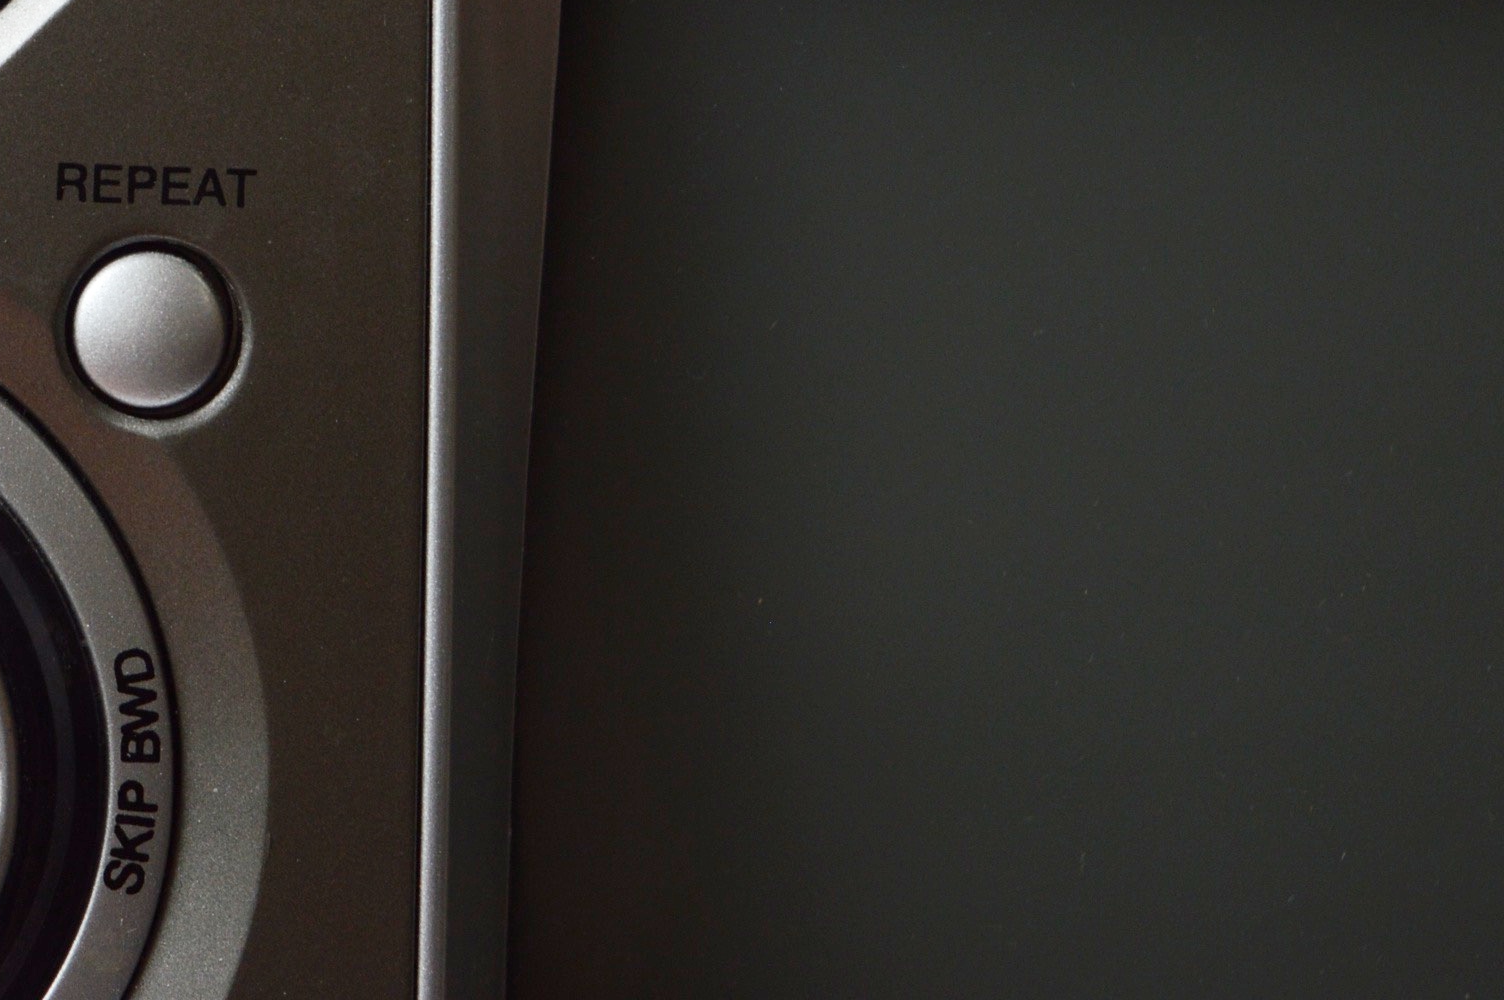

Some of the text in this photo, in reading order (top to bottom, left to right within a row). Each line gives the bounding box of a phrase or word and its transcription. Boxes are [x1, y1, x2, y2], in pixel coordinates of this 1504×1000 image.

[55, 161, 257, 209] REPEAT
[104, 646, 163, 896] SKIP BWD
